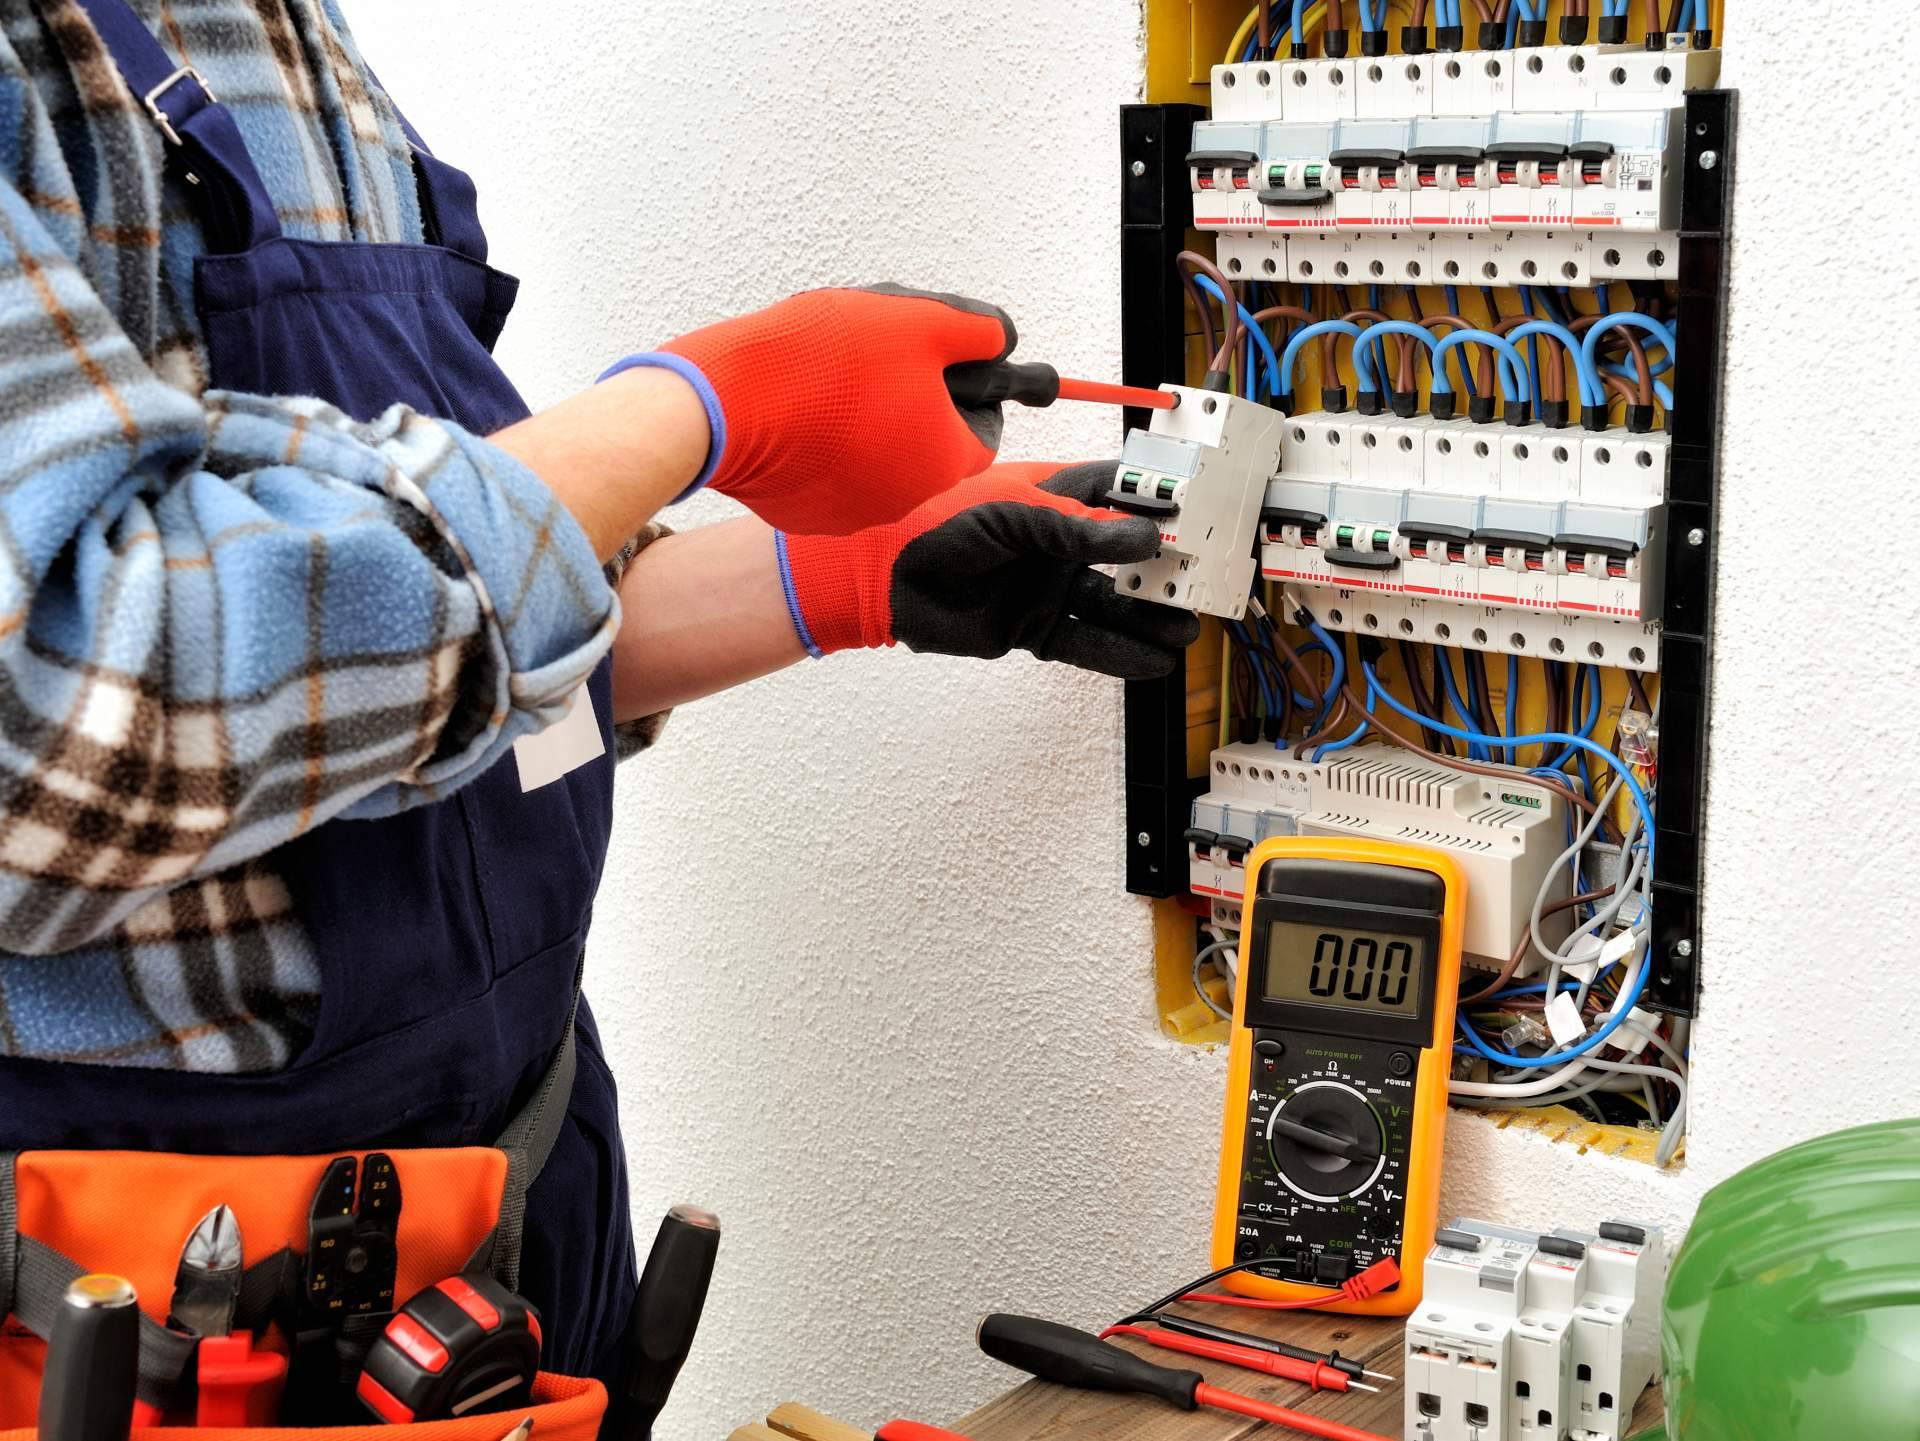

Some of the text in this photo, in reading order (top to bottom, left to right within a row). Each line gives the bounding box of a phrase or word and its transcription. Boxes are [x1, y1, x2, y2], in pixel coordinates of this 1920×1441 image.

[1179, 560, 1189, 570] N
[1309, 933, 1413, 1006] 000
[1385, 1078, 1411, 1087] POWER
[373, 1181, 387, 1190] 2.5
[1258, 1203, 1273, 1212] CX
[1291, 1206, 1299, 1216] F
[1341, 1205, 1356, 1213] hFE
[1239, 1226, 1259, 1237] 20A
[1286, 1234, 1303, 1243] mA
[1329, 1239, 1353, 1248] COM
